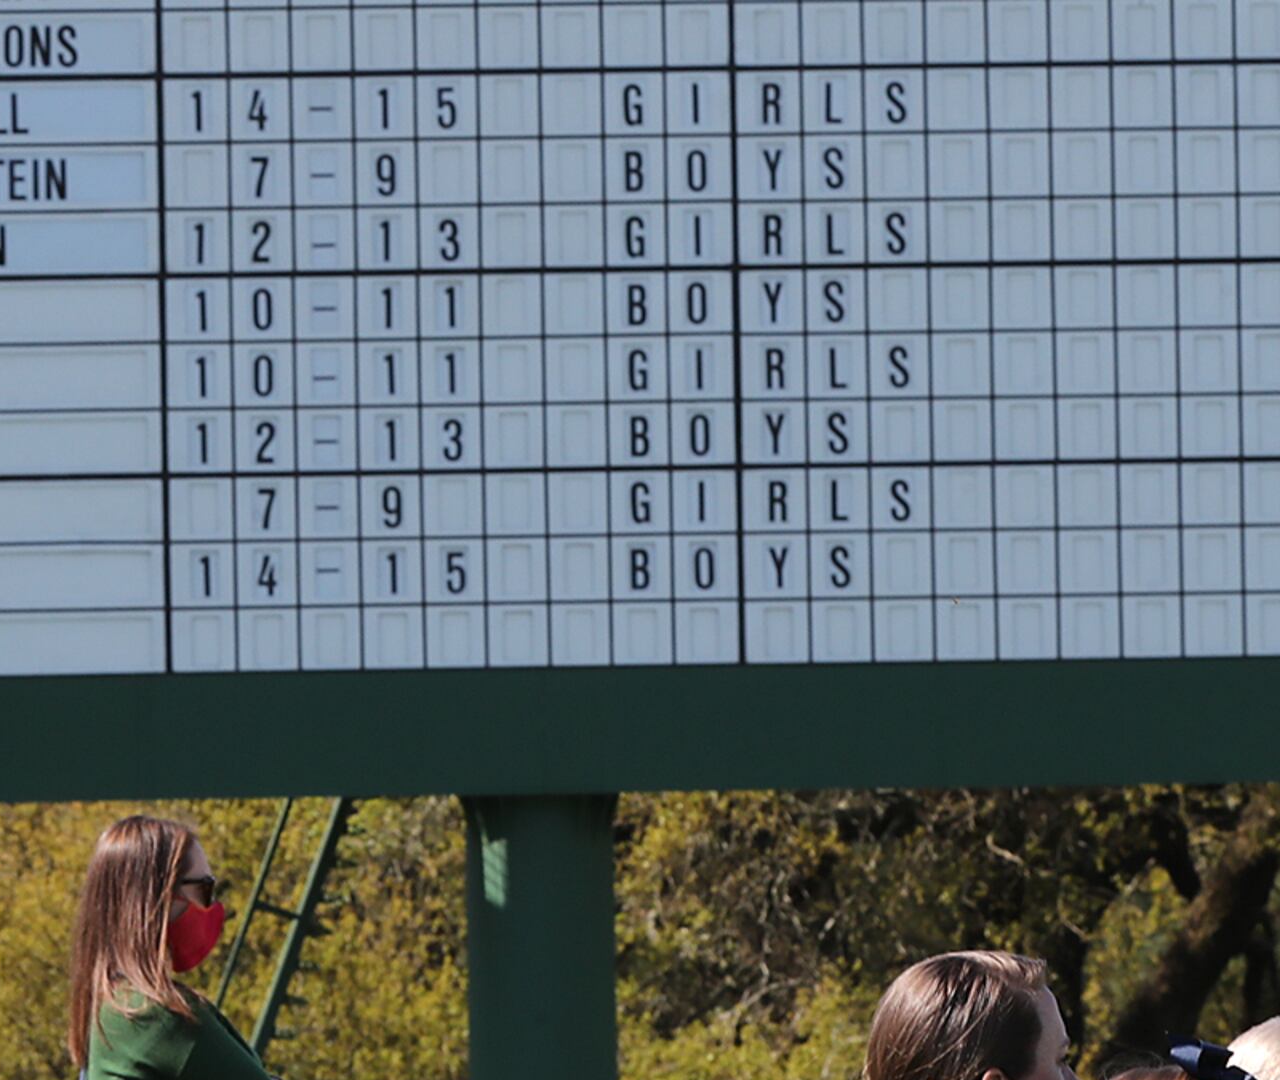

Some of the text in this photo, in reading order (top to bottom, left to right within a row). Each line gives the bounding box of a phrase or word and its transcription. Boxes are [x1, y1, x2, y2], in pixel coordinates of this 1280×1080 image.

[622, 80, 908, 128] GIRLS
[623, 146, 846, 194] BOYS
[624, 211, 907, 260] GIRLS
[626, 279, 846, 327] BOYS
[627, 344, 911, 393] GIRLS
[629, 410, 850, 459] BOYS
[629, 478, 912, 525] GIRLS
[629, 544, 852, 592] BOYS
